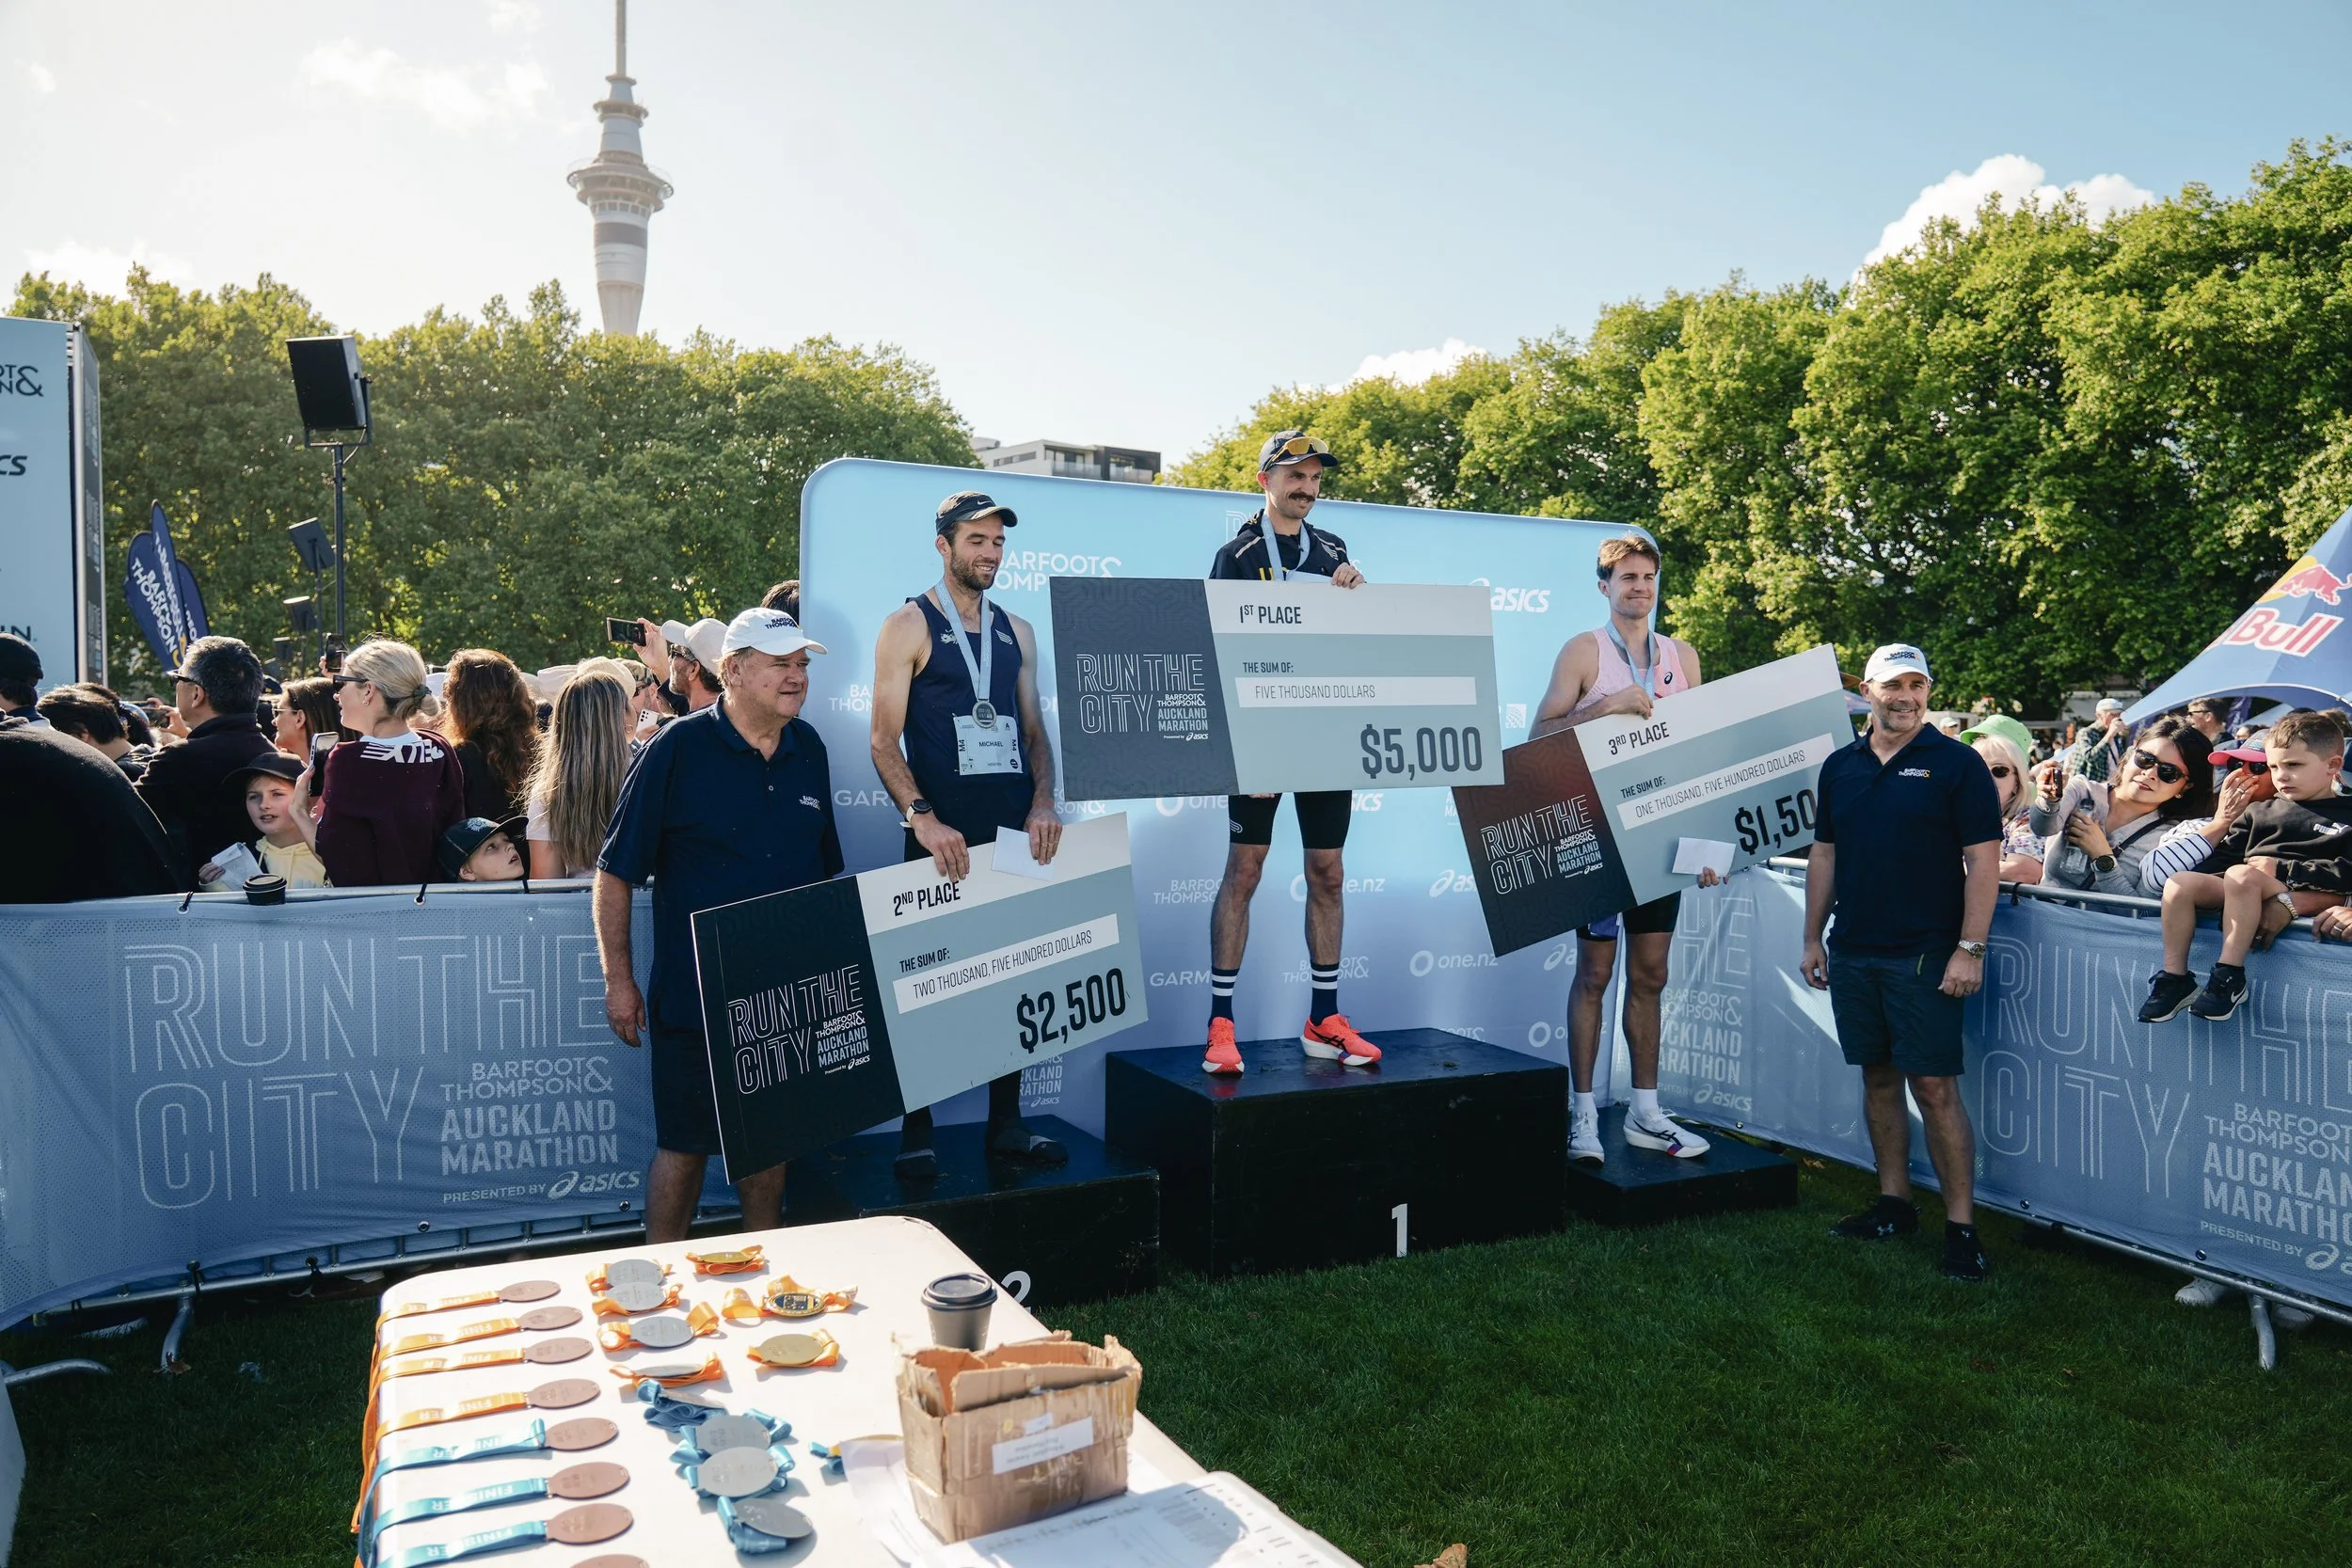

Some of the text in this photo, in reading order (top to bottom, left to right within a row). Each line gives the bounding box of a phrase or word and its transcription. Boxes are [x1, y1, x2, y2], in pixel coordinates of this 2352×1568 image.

[1001, 549, 1101, 574] ARFOOT
[132, 557, 179, 653] THOMPSON
[1239, 605, 1302, 624] 1ST PLACE
[2226, 609, 2341, 656] Bull
[1076, 654, 1204, 692] RUN THE
[1243, 662, 1294, 673] THE SUM OF:
[1255, 685, 1375, 699] FIVE THOUSAND DOLLARS
[1080, 694, 1153, 734] CITY
[1158, 708, 1207, 720] AUCKLAND
[1158, 720, 1208, 732] MARATHON
[959, 739, 966, 752] M4
[1360, 723, 1483, 781] $5,000
[1608, 721, 1670, 755] 3RD PLACE
[834, 790, 892, 806] GAR
[1621, 775, 1666, 800] THE SUM OF:
[1635, 750, 1805, 818] ONE THOUSAND, FIVE HUNDRED DOLLARS
[1480, 794, 1594, 862] RUN THE
[1560, 831, 1587, 845] BARFOOT
[1735, 788, 1818, 856] $1,50
[1554, 837, 1588, 852] THOMPSON
[1557, 840, 1599, 863] AUCKLAND
[1490, 843, 1553, 895] CITY
[1558, 850, 1602, 874] MARATHON
[894, 880, 961, 916] 2ND PLACE
[1153, 891, 1217, 904] THOMPSO
[1170, 879, 1223, 892] BARFOO
[1345, 879, 1386, 893] e.nz
[1670, 896, 1753, 990] HE
[899, 947, 949, 974] THE SUM OF:
[914, 930, 1092, 999] TWO THOUSAND, FIVE HUNDRED DOLLARS
[1438, 953, 1499, 970] one.nz
[1150, 970, 1211, 987] GARM
[124, 935, 614, 1072] RUN THE
[728, 964, 864, 1047] RUN THE
[1016, 968, 1126, 1054] $2,500
[1664, 988, 1728, 1008] BARFOOT
[1665, 1001, 1724, 1022] OMPSON
[1982, 935, 2155, 1073] RUN
[815, 1020, 856, 1038] THOMPSON
[823, 1012, 856, 1029] BARFOOT
[818, 1026, 867, 1053] AUCKLAND
[818, 1038, 869, 1068] MARATHON
[1661, 1020, 1742, 1057] CKLAND
[472, 1057, 585, 1081] BARFOOT
[736, 1026, 811, 1094] CITY
[1021, 1066, 1063, 1083] KLAND
[1659, 1046, 1740, 1085] ARATHON
[440, 1077, 582, 1101] THOMPSON
[1020, 1080, 1062, 1096] RATHON
[441, 1099, 616, 1142] AUCKLAND
[1981, 1051, 2190, 1198] CITY
[2234, 1102, 2352, 1145] BARFOOT
[135, 1068, 423, 1209] CITY
[2204, 1115, 2350, 1165] THOMPSON
[441, 1134, 618, 1176] MARATHON
[2202, 1142, 2352, 1208] AUCKLAN
[444, 1187, 525, 1203] PRESENTED
[530, 1183, 547, 1194] BY
[1391, 1203, 1408, 1259] 1
[2201, 1220, 2303, 1257] PRESENTED BY
[1001, 1271, 1031, 1314] 2
